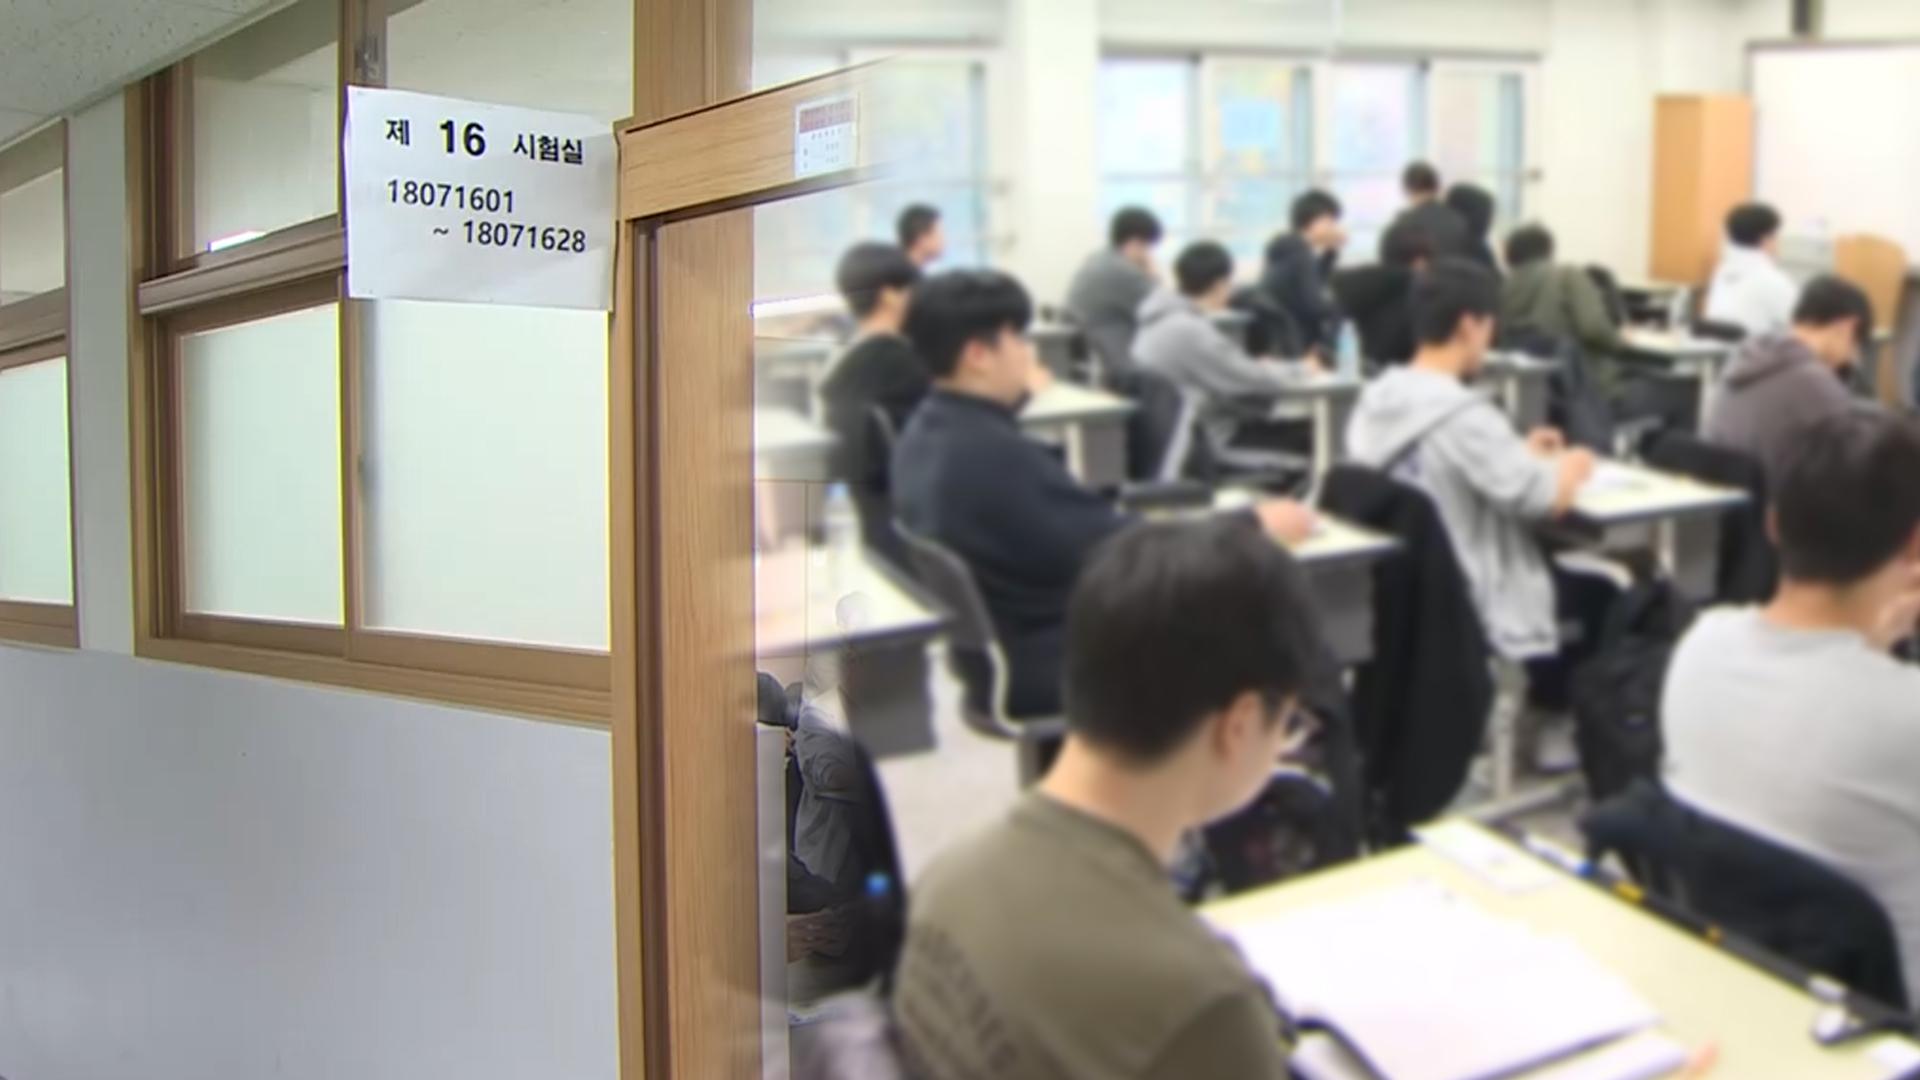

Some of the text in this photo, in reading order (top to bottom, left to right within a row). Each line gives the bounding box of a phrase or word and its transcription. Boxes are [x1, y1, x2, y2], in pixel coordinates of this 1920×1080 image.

[385, 119, 584, 166] 제 16 시험실
[387, 178, 514, 214] 18071601
[463, 219, 586, 254] 18071628
